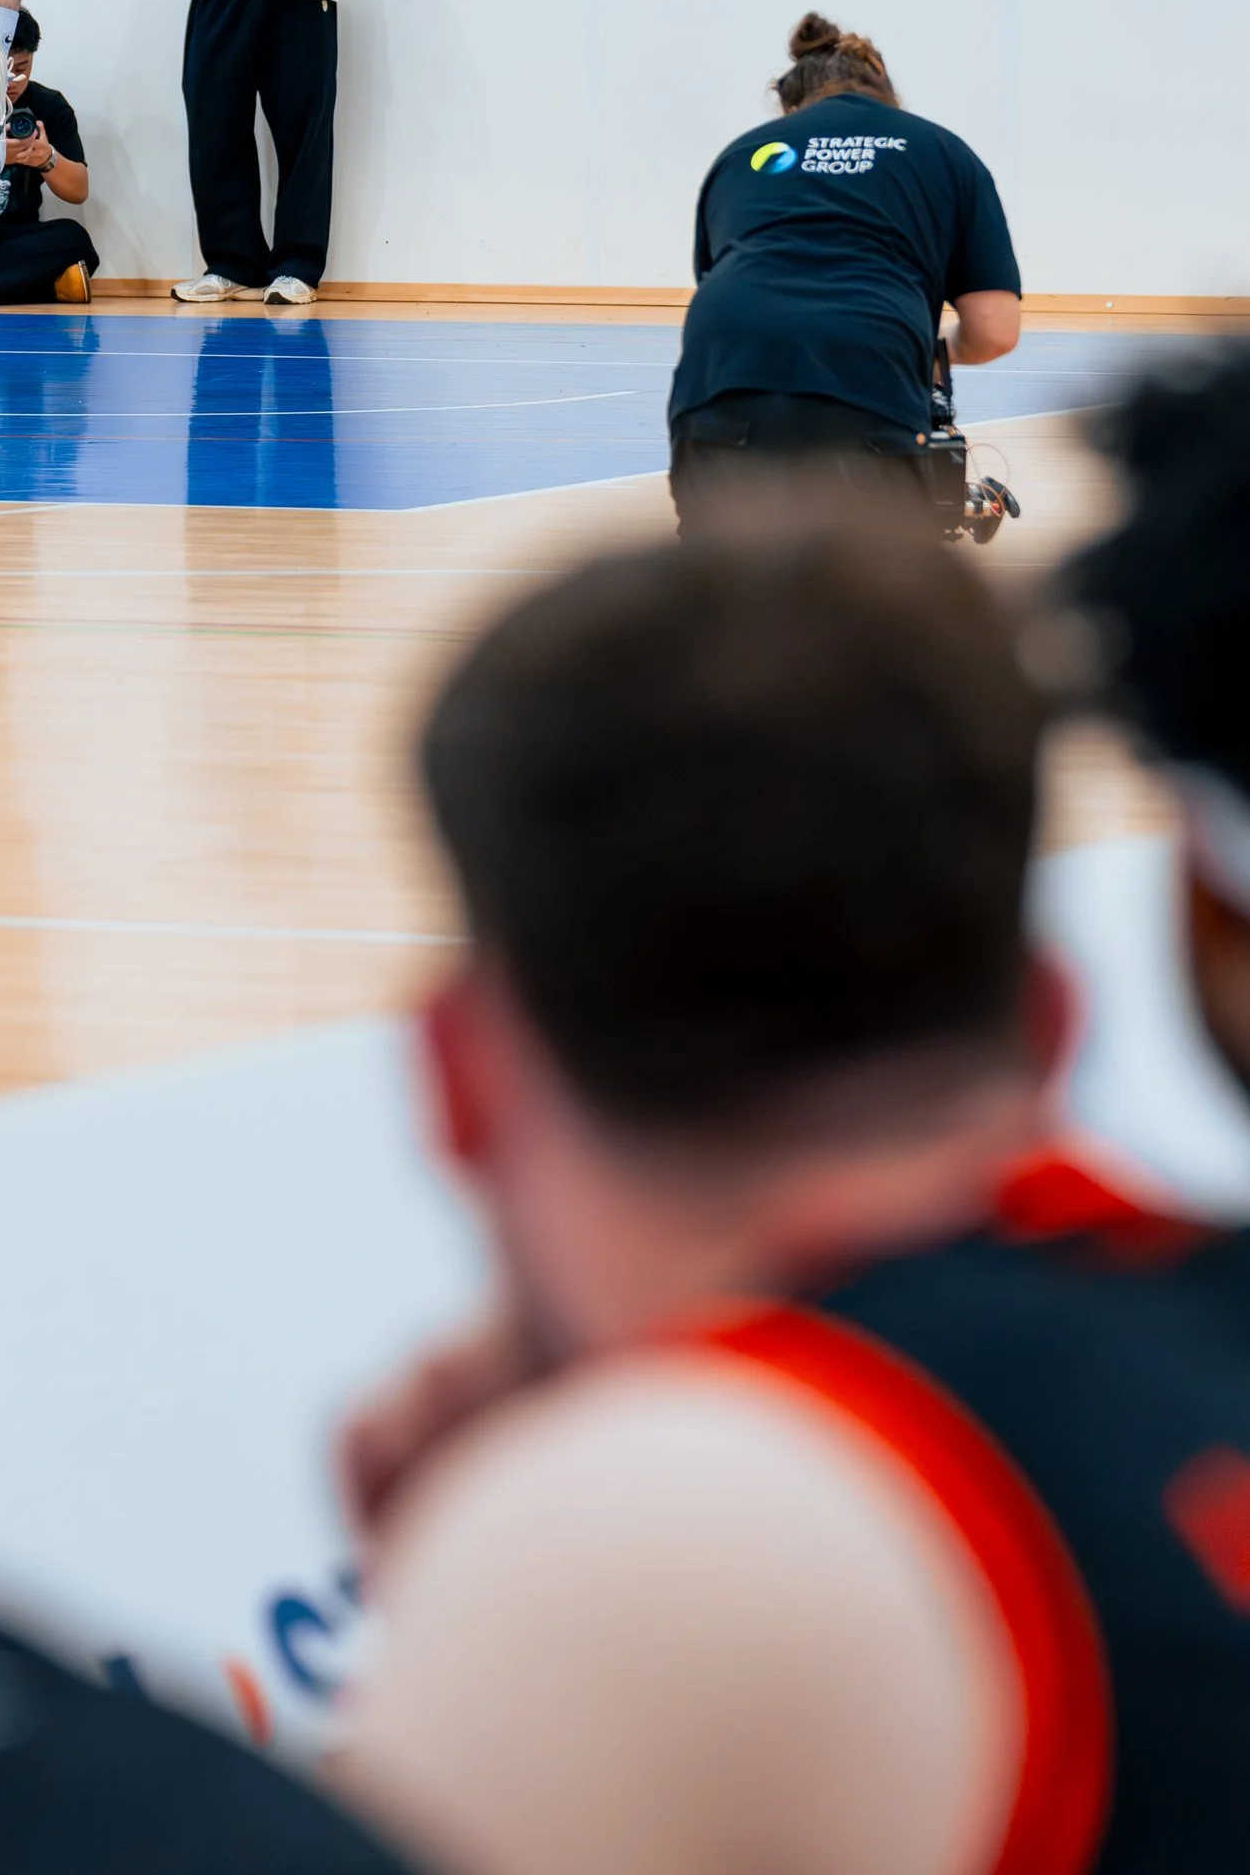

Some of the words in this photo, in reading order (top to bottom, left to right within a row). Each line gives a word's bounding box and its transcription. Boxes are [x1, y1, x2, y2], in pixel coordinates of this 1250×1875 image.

[808, 136, 908, 151] STRATEGIC
[805, 148, 875, 160] POWER
[801, 160, 874, 174] GROUP
